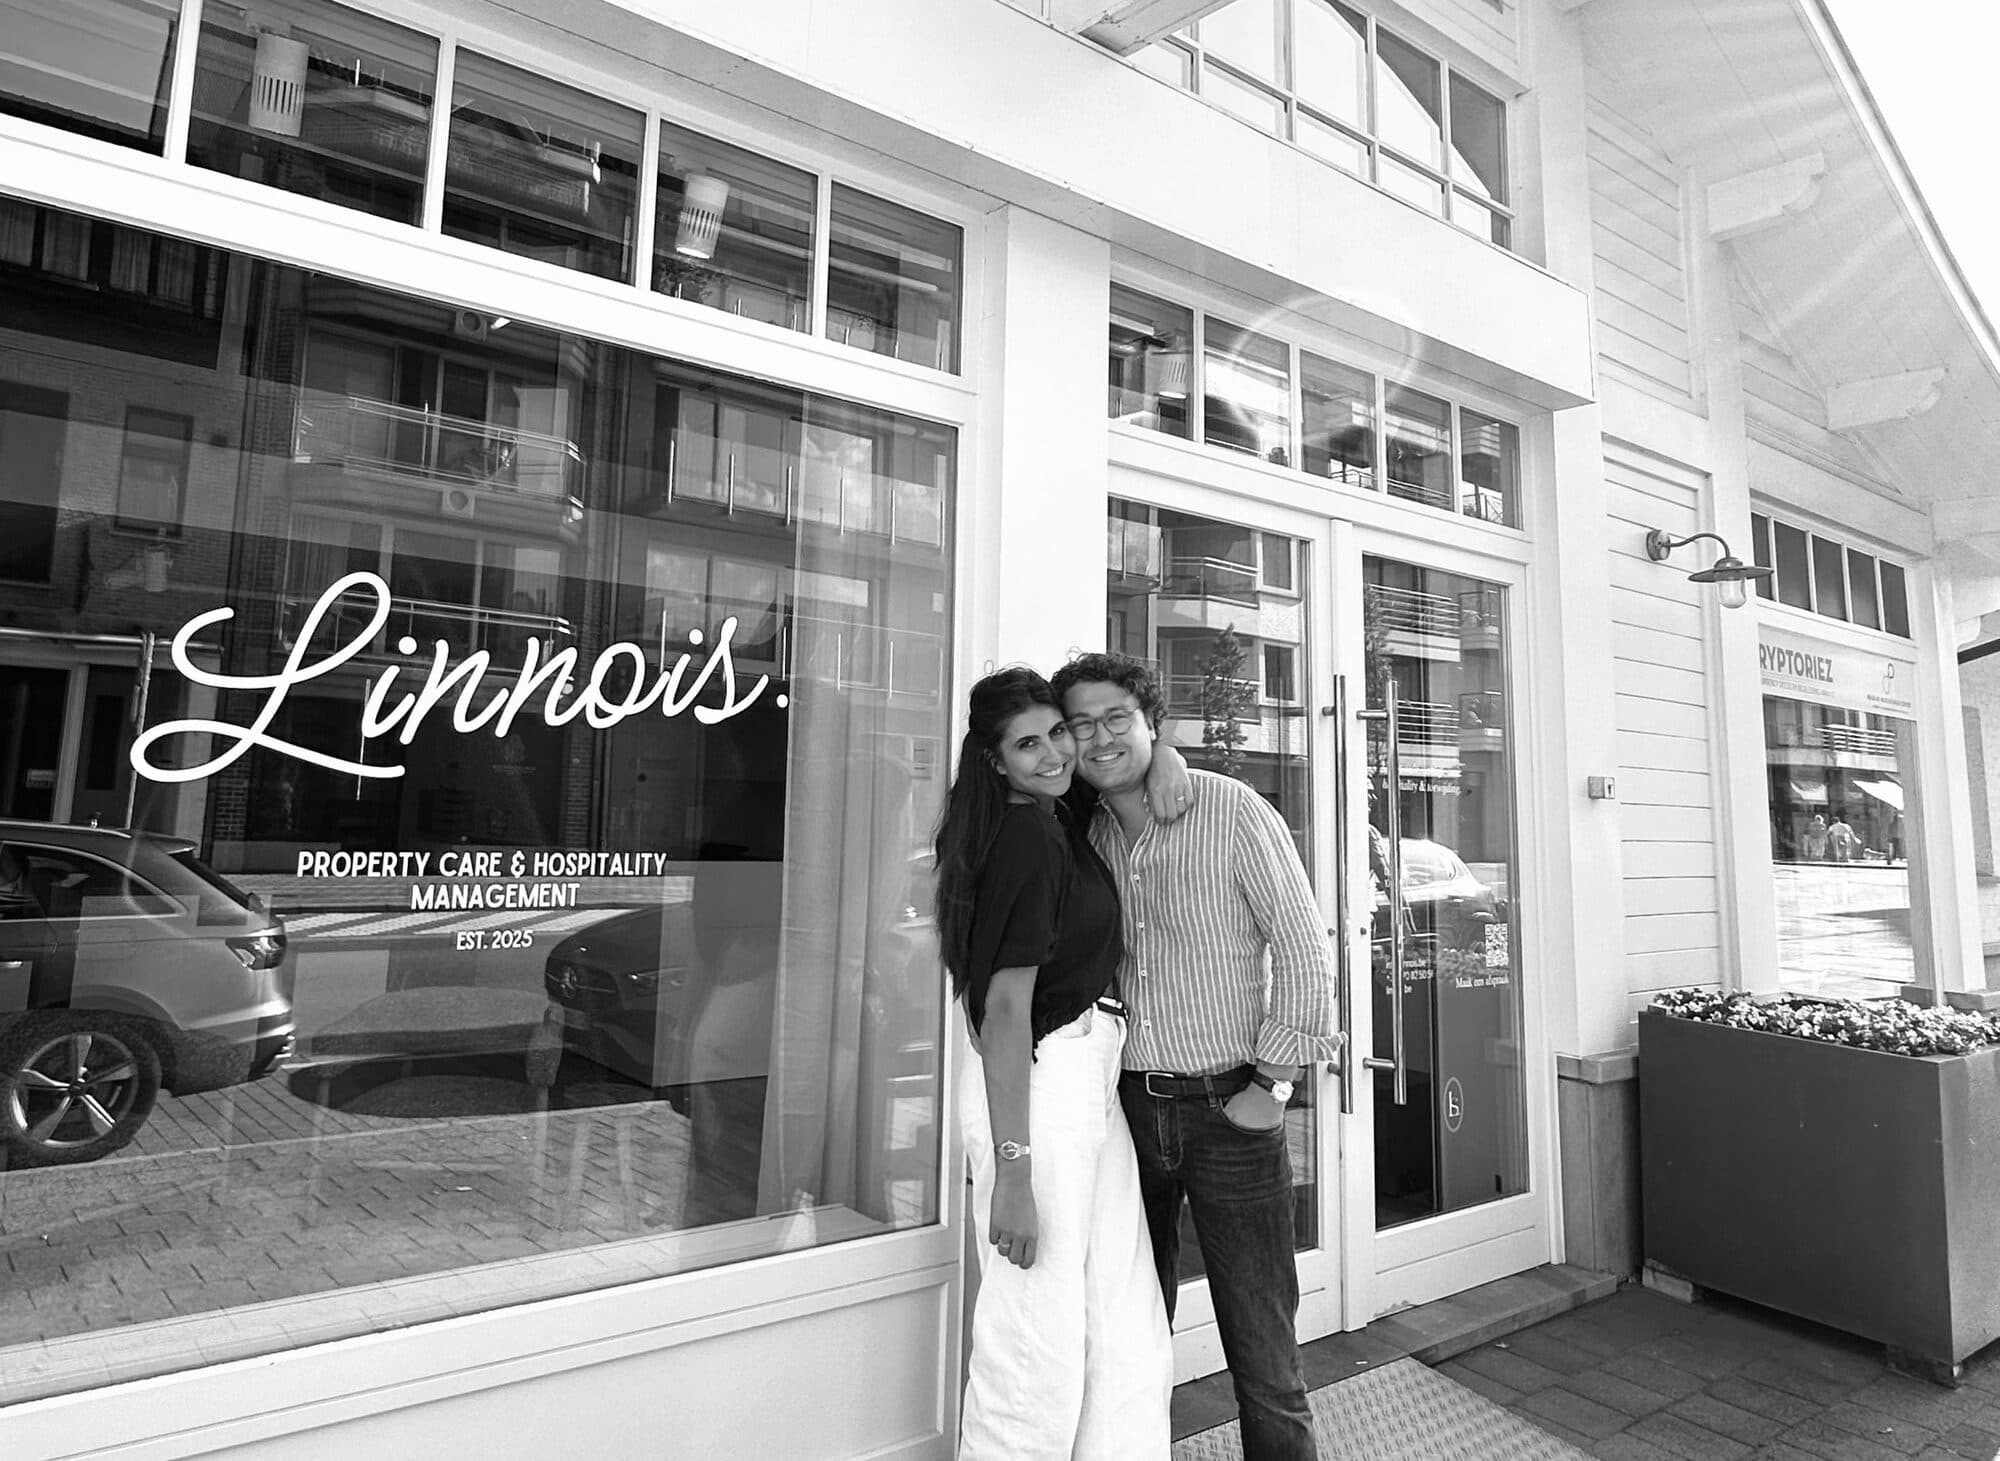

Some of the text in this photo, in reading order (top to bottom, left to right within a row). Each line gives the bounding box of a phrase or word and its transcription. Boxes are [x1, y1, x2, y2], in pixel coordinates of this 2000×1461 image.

[130, 571, 790, 783] Linnois.
[297, 850, 667, 879] PROPERTY CARE & HOSPITALITY
[411, 883, 580, 910] MANAGEMENT
[456, 930, 533, 951] EST. 2025
